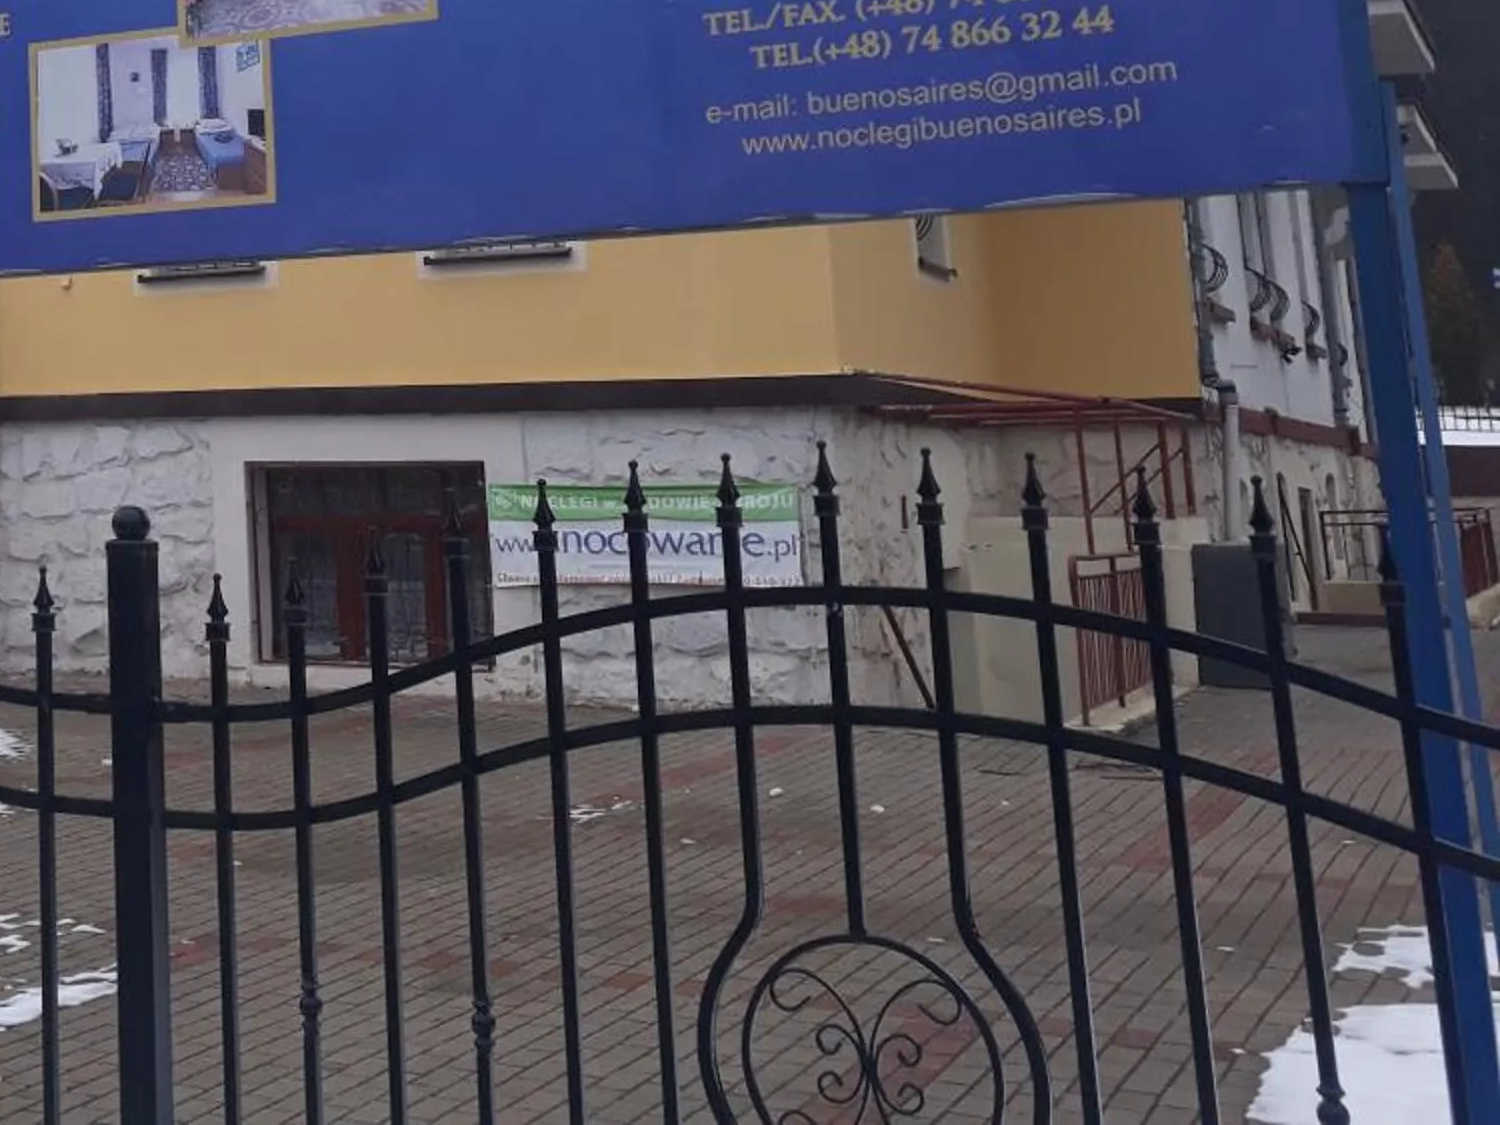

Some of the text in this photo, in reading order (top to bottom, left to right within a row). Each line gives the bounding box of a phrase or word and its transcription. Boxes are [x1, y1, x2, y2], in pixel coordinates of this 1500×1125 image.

[704, 0, 846, 37] TEL./FAX.
[901, 24, 943, 54] 74
[950, 16, 1012, 49] 866
[1020, 11, 1063, 42] 32
[1071, 5, 1116, 36] 44
[705, 60, 1179, 126] e-mail: buenosaires@gmail.com
[742, 98, 1142, 156] www.noclegibuenosaires.pl
[520, 493, 598, 509] NCLEGI
